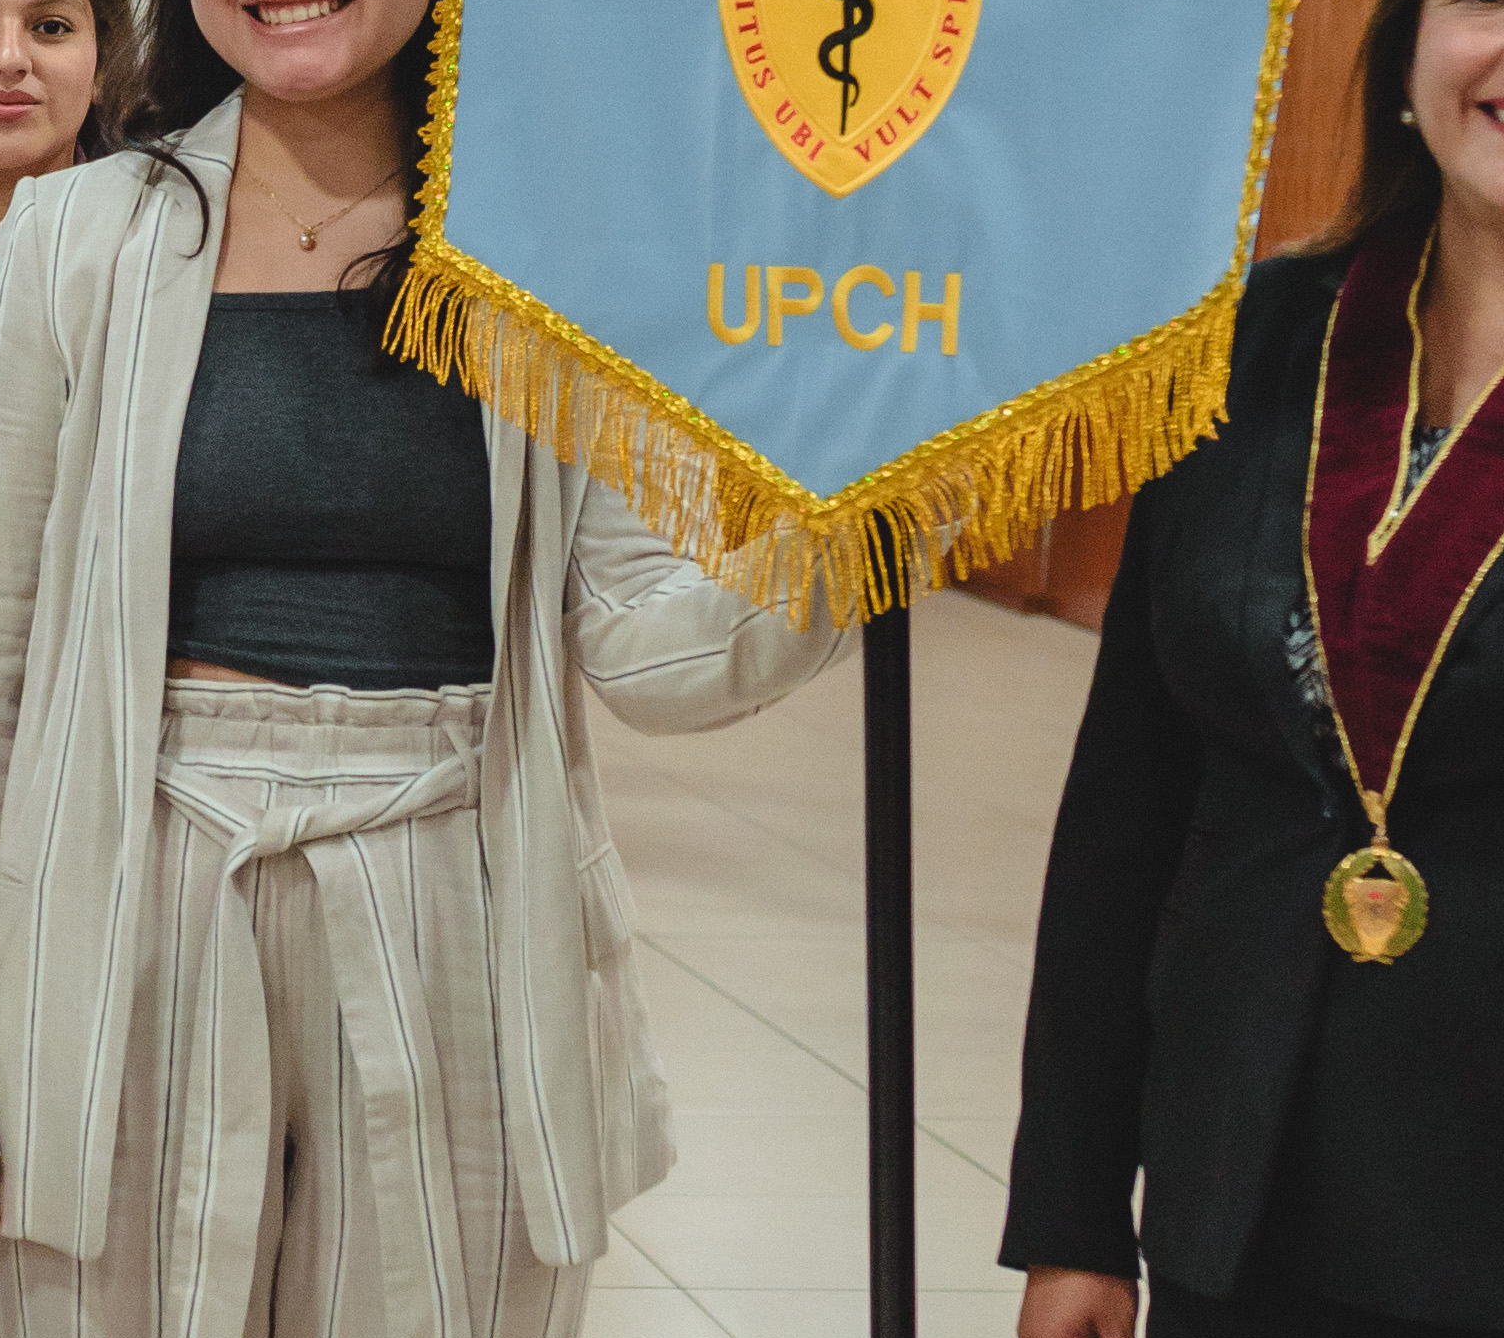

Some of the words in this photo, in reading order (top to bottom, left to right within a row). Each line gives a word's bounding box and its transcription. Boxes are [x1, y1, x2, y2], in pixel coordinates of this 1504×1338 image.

[774, 99, 827, 163] UBI
[852, 76, 935, 164] VULT
[705, 262, 962, 357] UPCH
